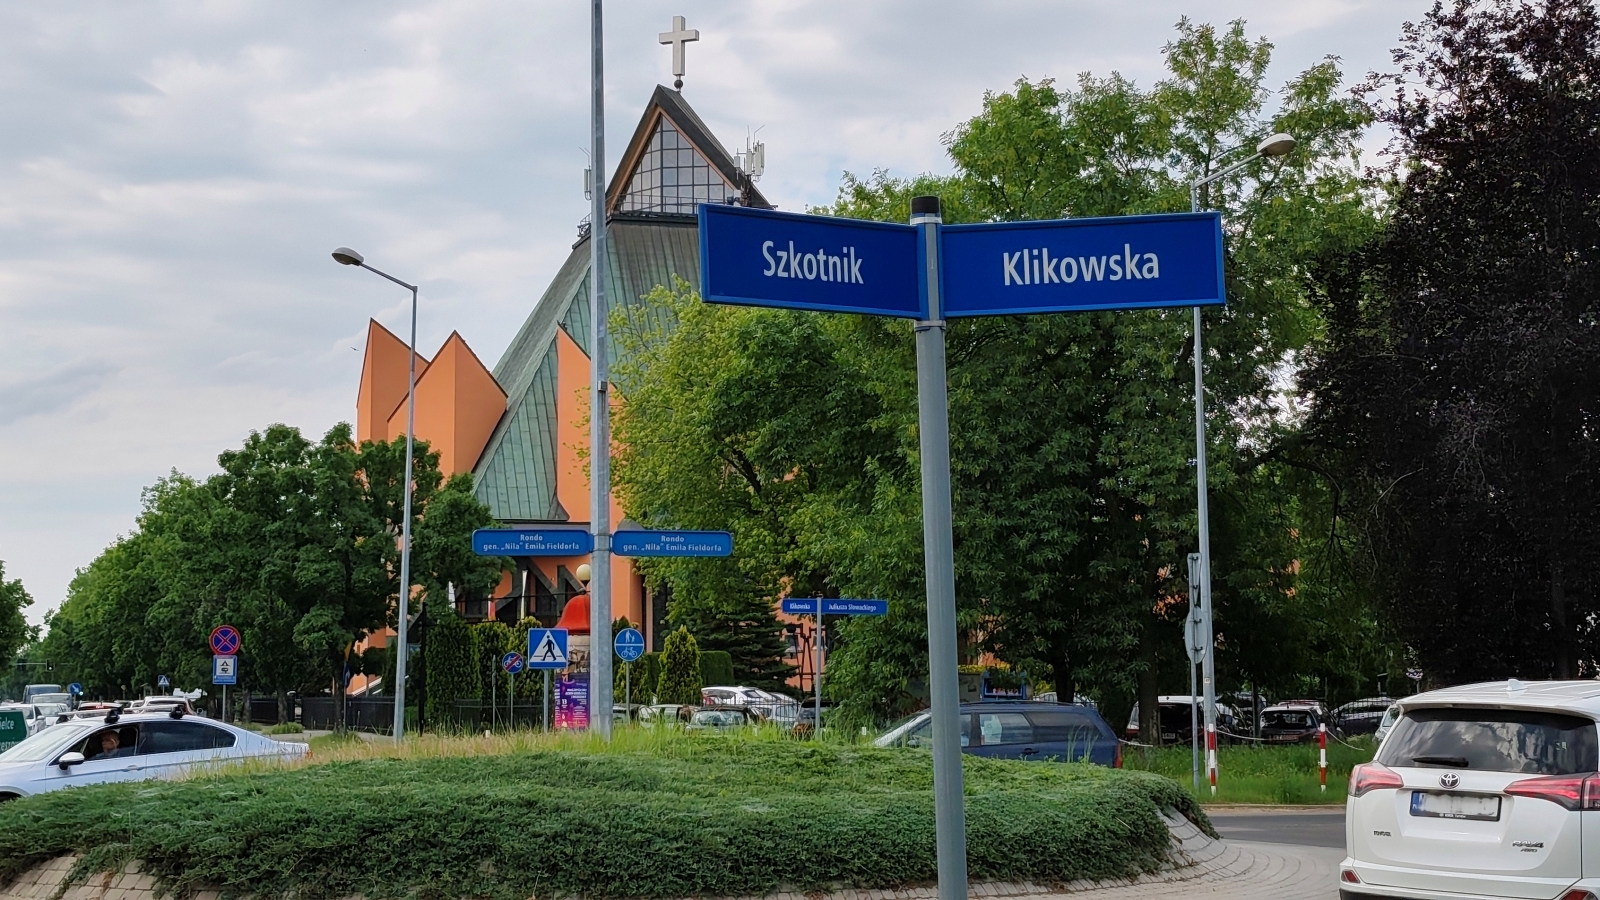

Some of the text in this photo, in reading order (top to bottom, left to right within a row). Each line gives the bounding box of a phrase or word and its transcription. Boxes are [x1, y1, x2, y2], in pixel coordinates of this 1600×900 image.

[762, 240, 864, 284] Szkotnik
[1003, 243, 1159, 286] Klikowska
[525, 542, 545, 550] Emila
[688, 544, 722, 552] Fieldorfa
